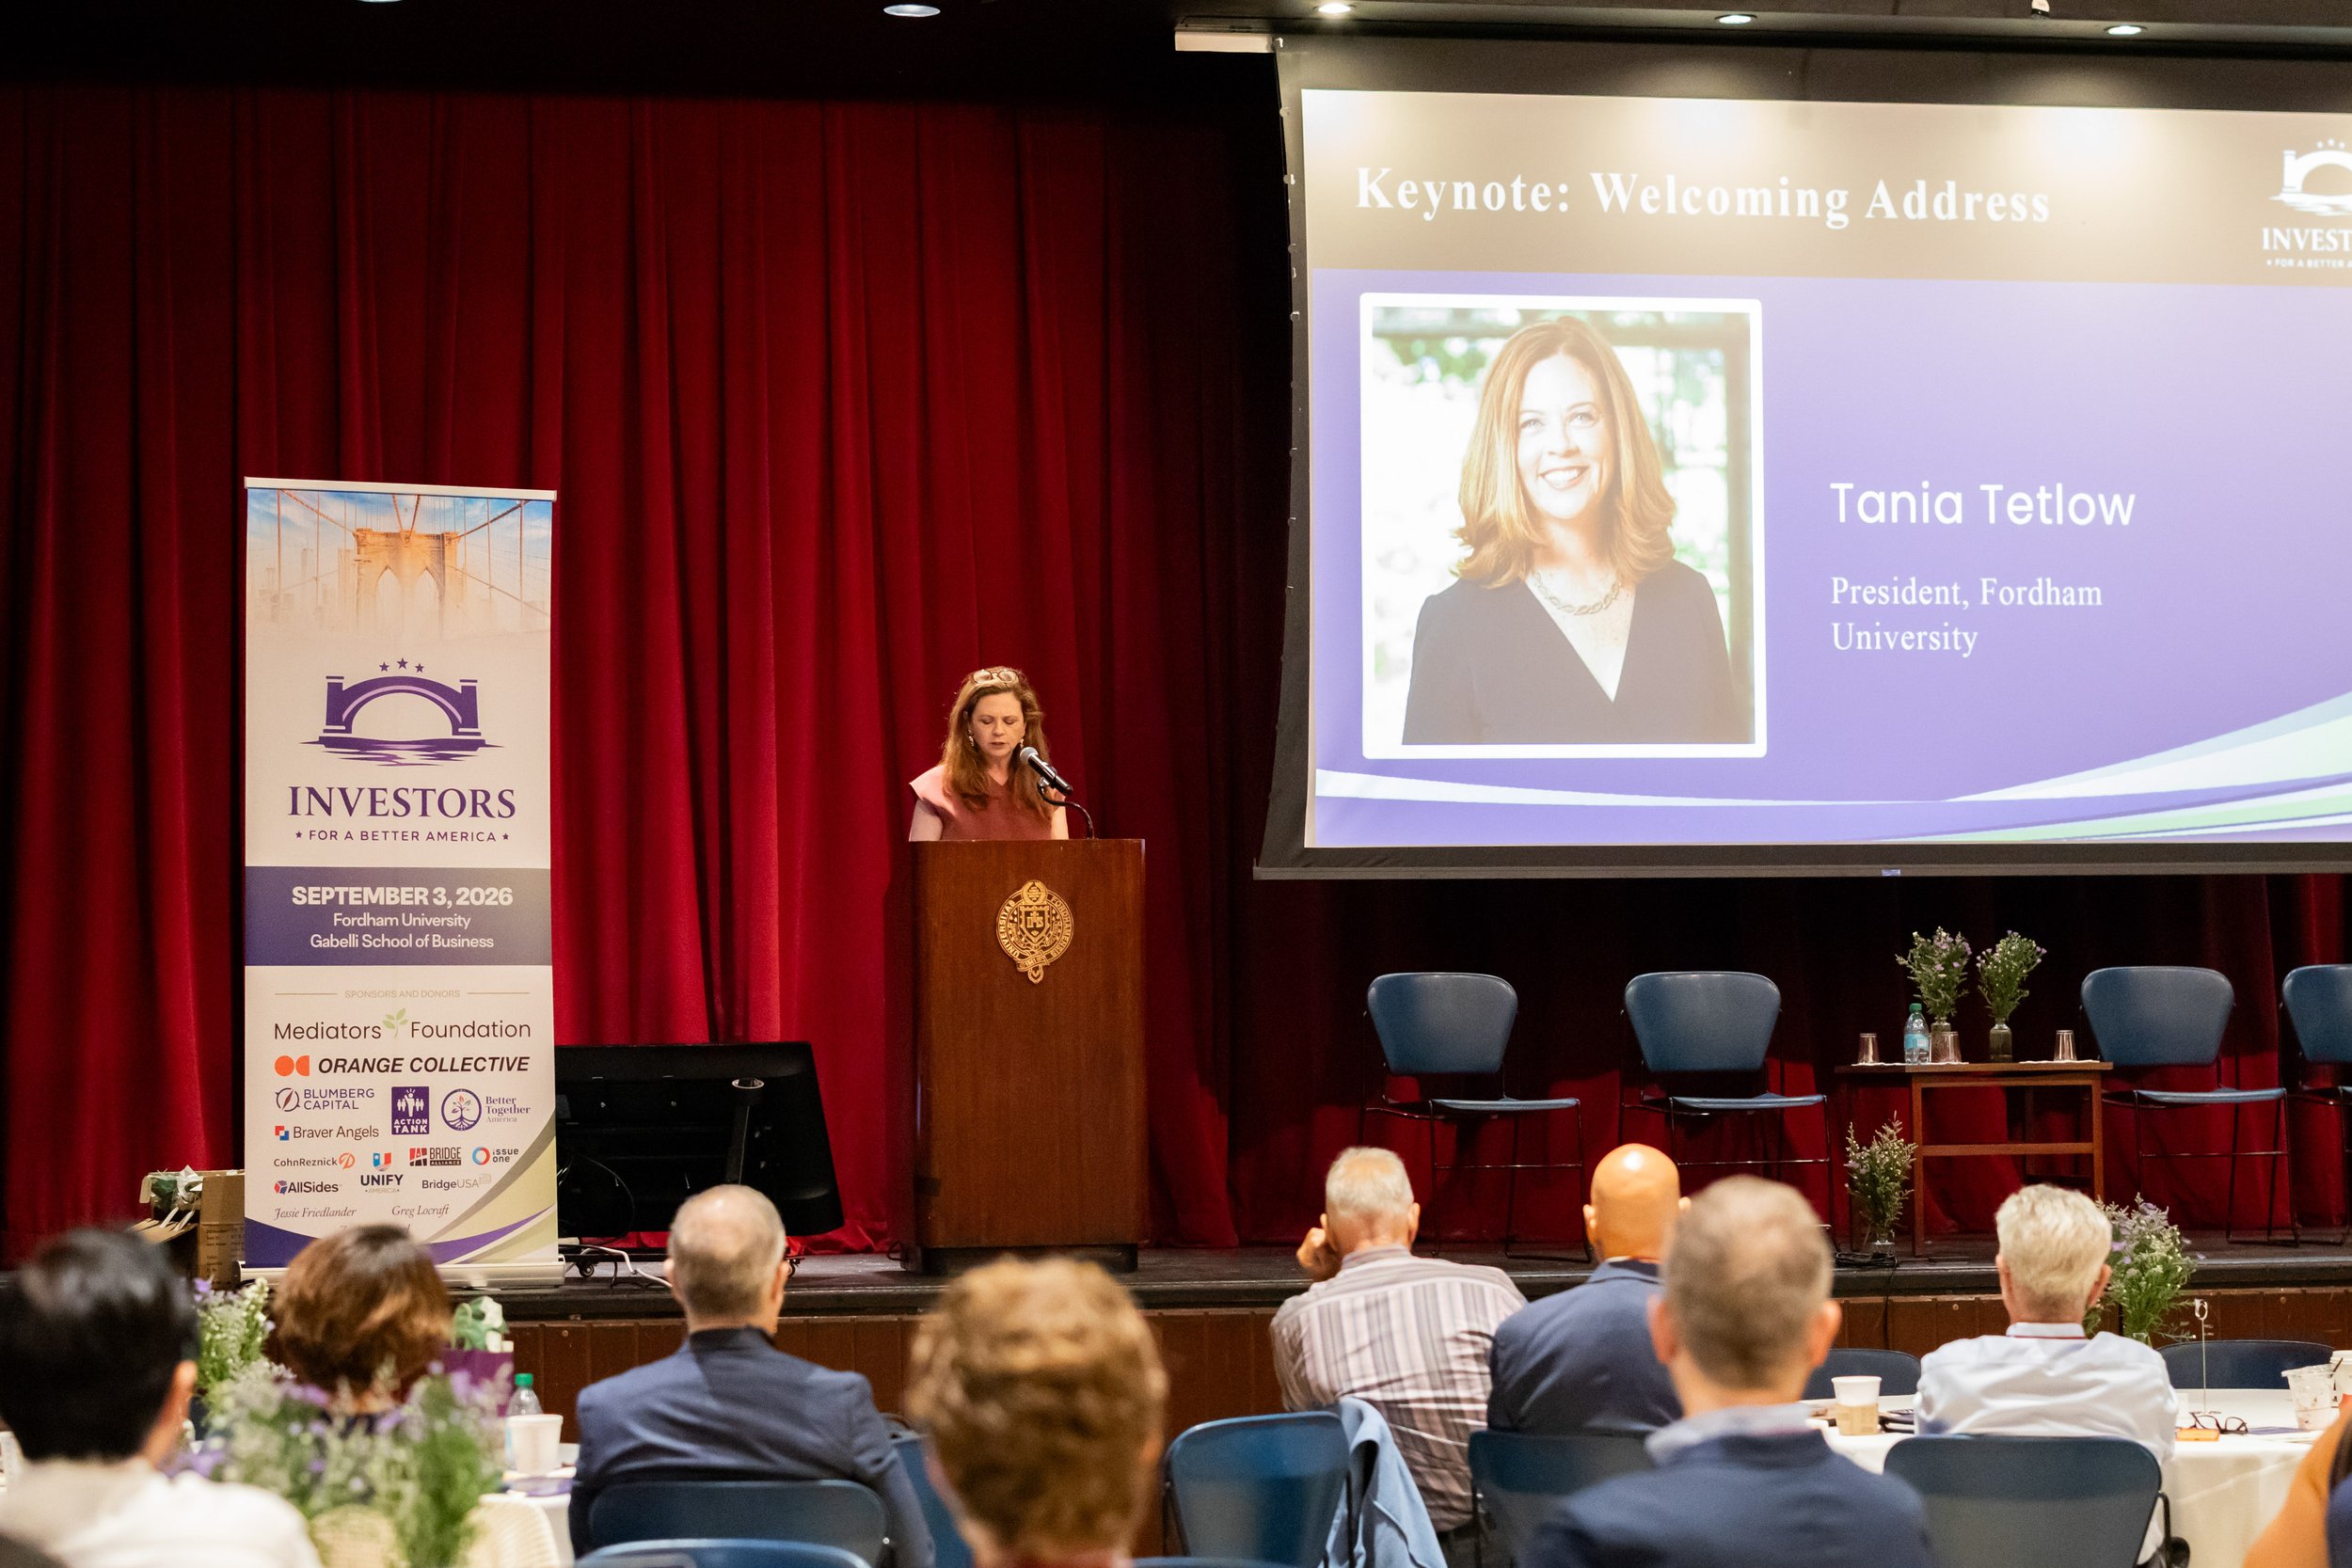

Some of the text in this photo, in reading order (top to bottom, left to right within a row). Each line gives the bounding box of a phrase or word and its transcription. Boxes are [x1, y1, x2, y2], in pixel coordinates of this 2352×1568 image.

[1356, 167, 2050, 230] Keynote: Welcoming Address
[2275, 258, 2295, 267] FOR
[2297, 258, 2304, 267] A
[2307, 258, 2344, 268] BETTER
[1830, 481, 2136, 526] Tania Tetlow
[1831, 577, 2103, 610] President, Fordham
[1832, 622, 1979, 658] University
[288, 785, 516, 818] INVESTORS
[309, 830, 497, 842] FOR A BETTER AMERICA
[292, 886, 514, 910] SEPTEMBER 3, 2026
[333, 912, 471, 929] Fordham University
[310, 934, 495, 948] Gabelli School of Business
[344, 990, 461, 999] SPONSORS AND DONORS
[274, 1021, 532, 1039] Mediators Foundation
[318, 1056, 531, 1073] ORANGE COLLECTIVE
[304, 1088, 374, 1099] BLUMBERG
[304, 1100, 359, 1110] CAPITAL
[485, 1096, 516, 1105] Better
[485, 1104, 531, 1117] Together
[294, 1125, 380, 1141] Braver Angels
[393, 1125, 428, 1133] TANK
[429, 1147, 462, 1160] BRIDGE
[492, 1148, 519, 1156] issue
[274, 1156, 338, 1167] CohnReznick
[360, 1174, 404, 1186] UNIFY
[421, 1179, 480, 1191] BridgeUSA
[288, 1181, 339, 1193] AllSides
[274, 1206, 358, 1220] Jessie Friedlander
[391, 1204, 450, 1219] Greg Locraft
